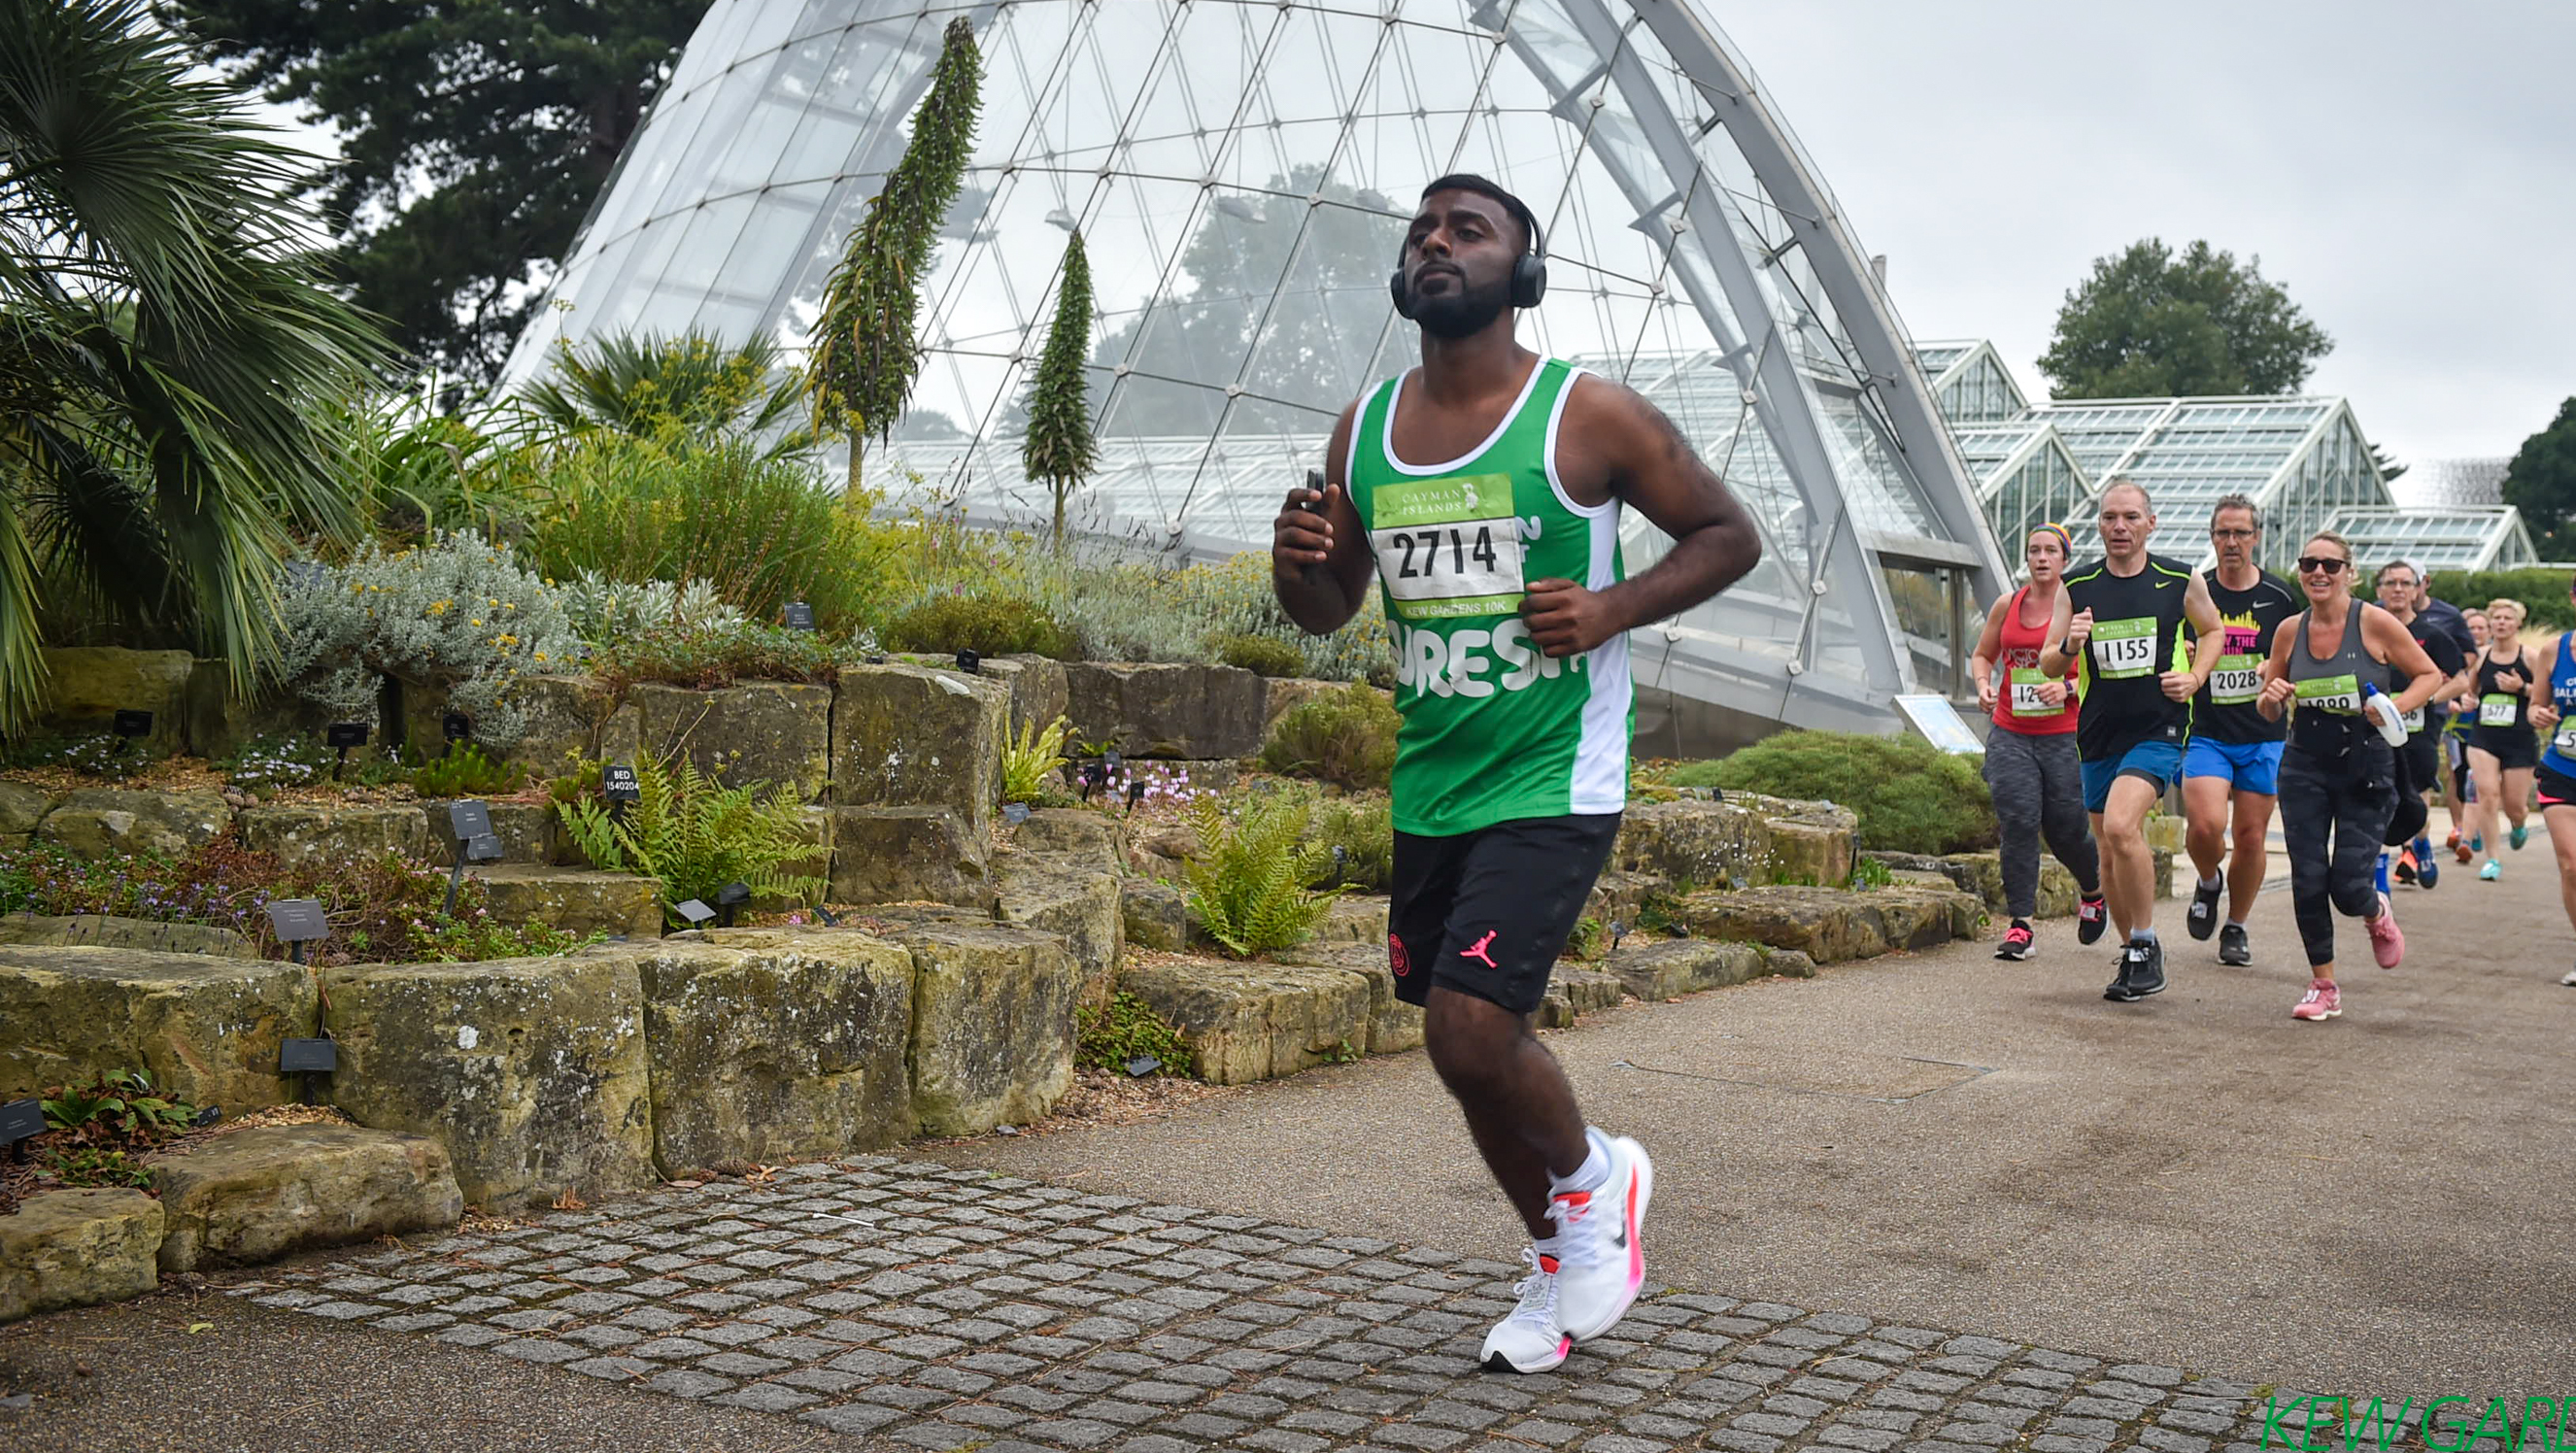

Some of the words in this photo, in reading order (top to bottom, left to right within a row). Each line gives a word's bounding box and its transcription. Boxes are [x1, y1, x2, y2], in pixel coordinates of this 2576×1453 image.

[1401, 489, 1461, 504] CAYMAN
[1402, 501, 1463, 516] ISLANDS
[1393, 525, 1497, 579] 2714
[1406, 605, 1428, 617] KEW
[1430, 602, 1481, 618] GARDENS
[1485, 600, 1507, 613] 10K
[2104, 638, 2149, 662] 1155
[2217, 671, 2256, 690] 2028
[613, 770, 630, 780] BED
[606, 781, 639, 792] 1540204
